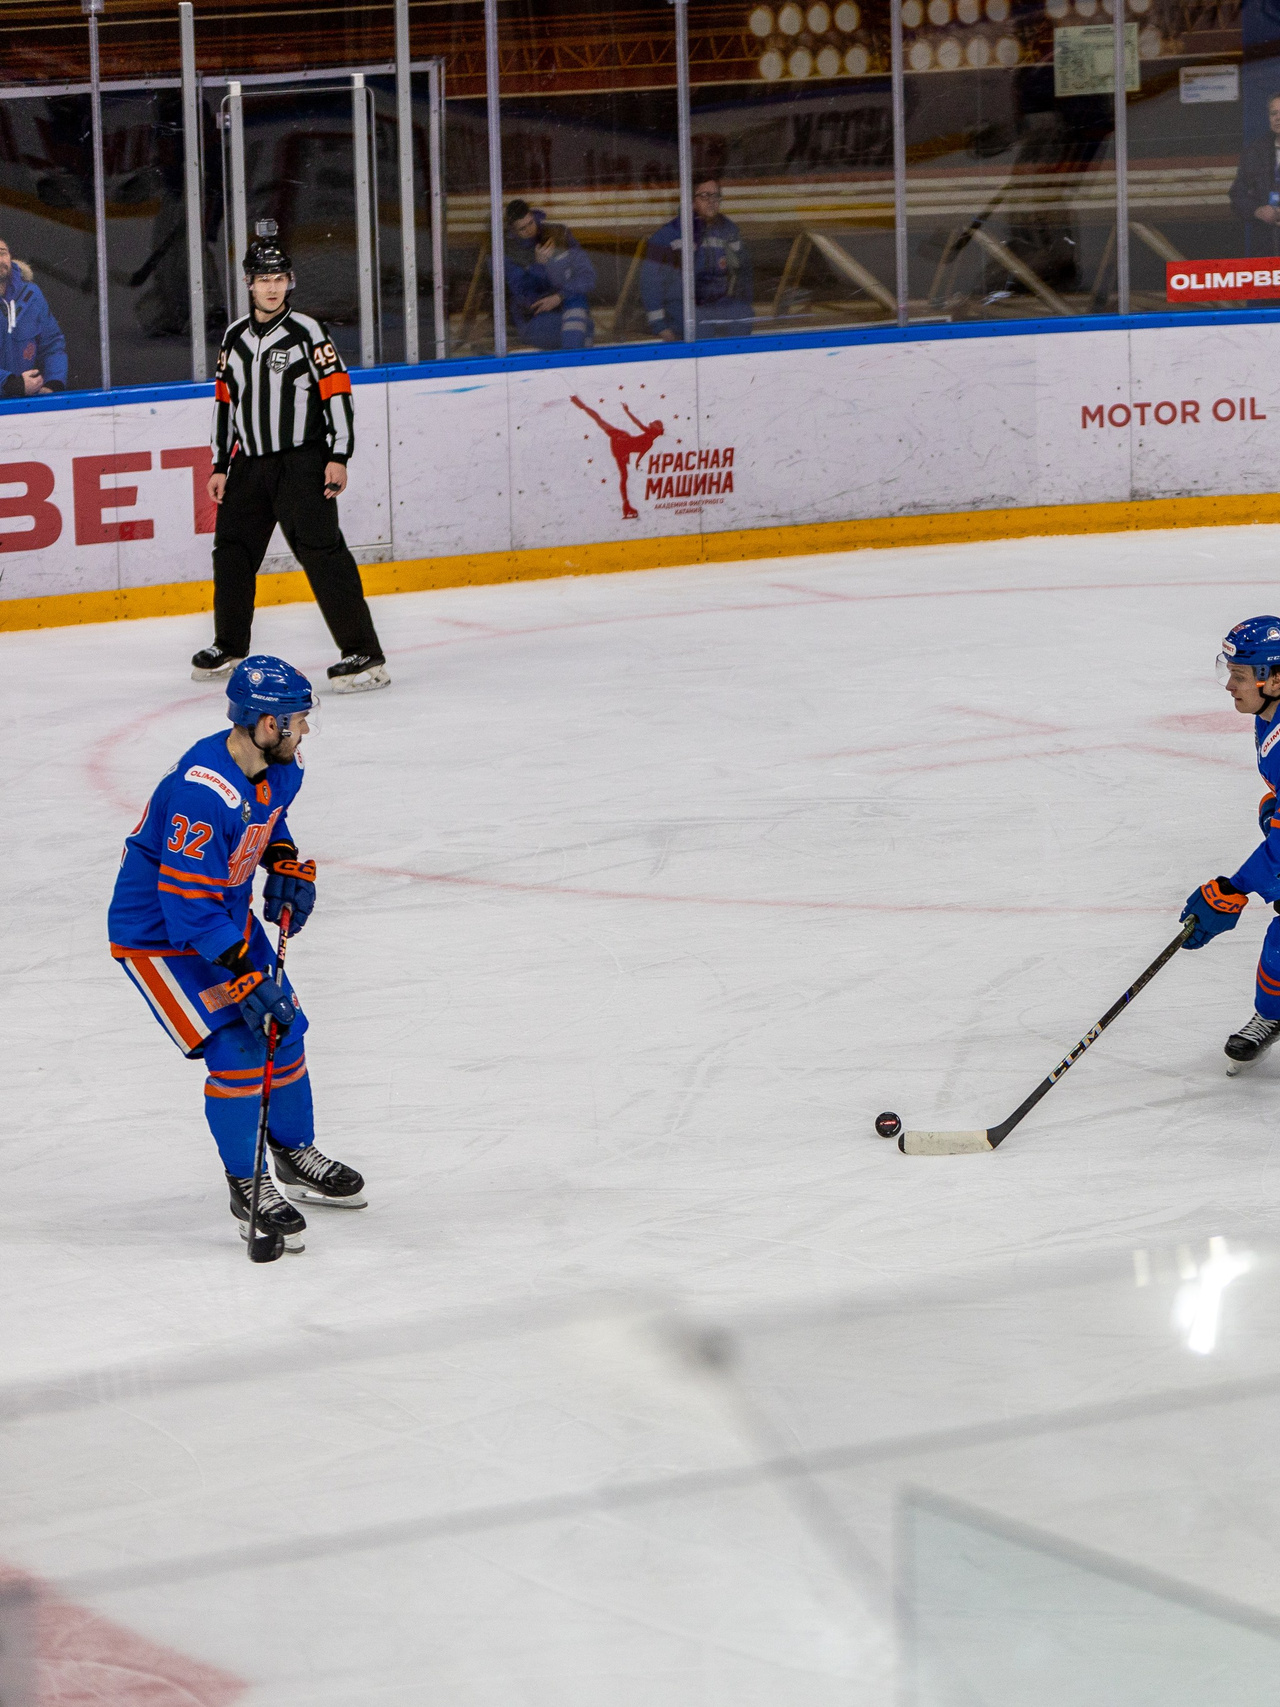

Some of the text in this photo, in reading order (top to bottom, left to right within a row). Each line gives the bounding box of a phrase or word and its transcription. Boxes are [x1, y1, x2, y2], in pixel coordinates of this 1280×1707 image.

[313, 343, 337, 367] 49
[1081, 397, 1266, 429] MOTOR OIL
[647, 447, 735, 475] КРАСНАЯ
[645, 470, 734, 501] МАШИНА
[654, 498, 725, 510] АКАДЕМИЯ ФИГУРНОГО
[674, 507, 703, 515] КАТАНИЯ
[190, 770, 237, 801] OLIMPBET
[166, 812, 214, 860] 32
[1048, 1022, 1103, 1084] CCM
